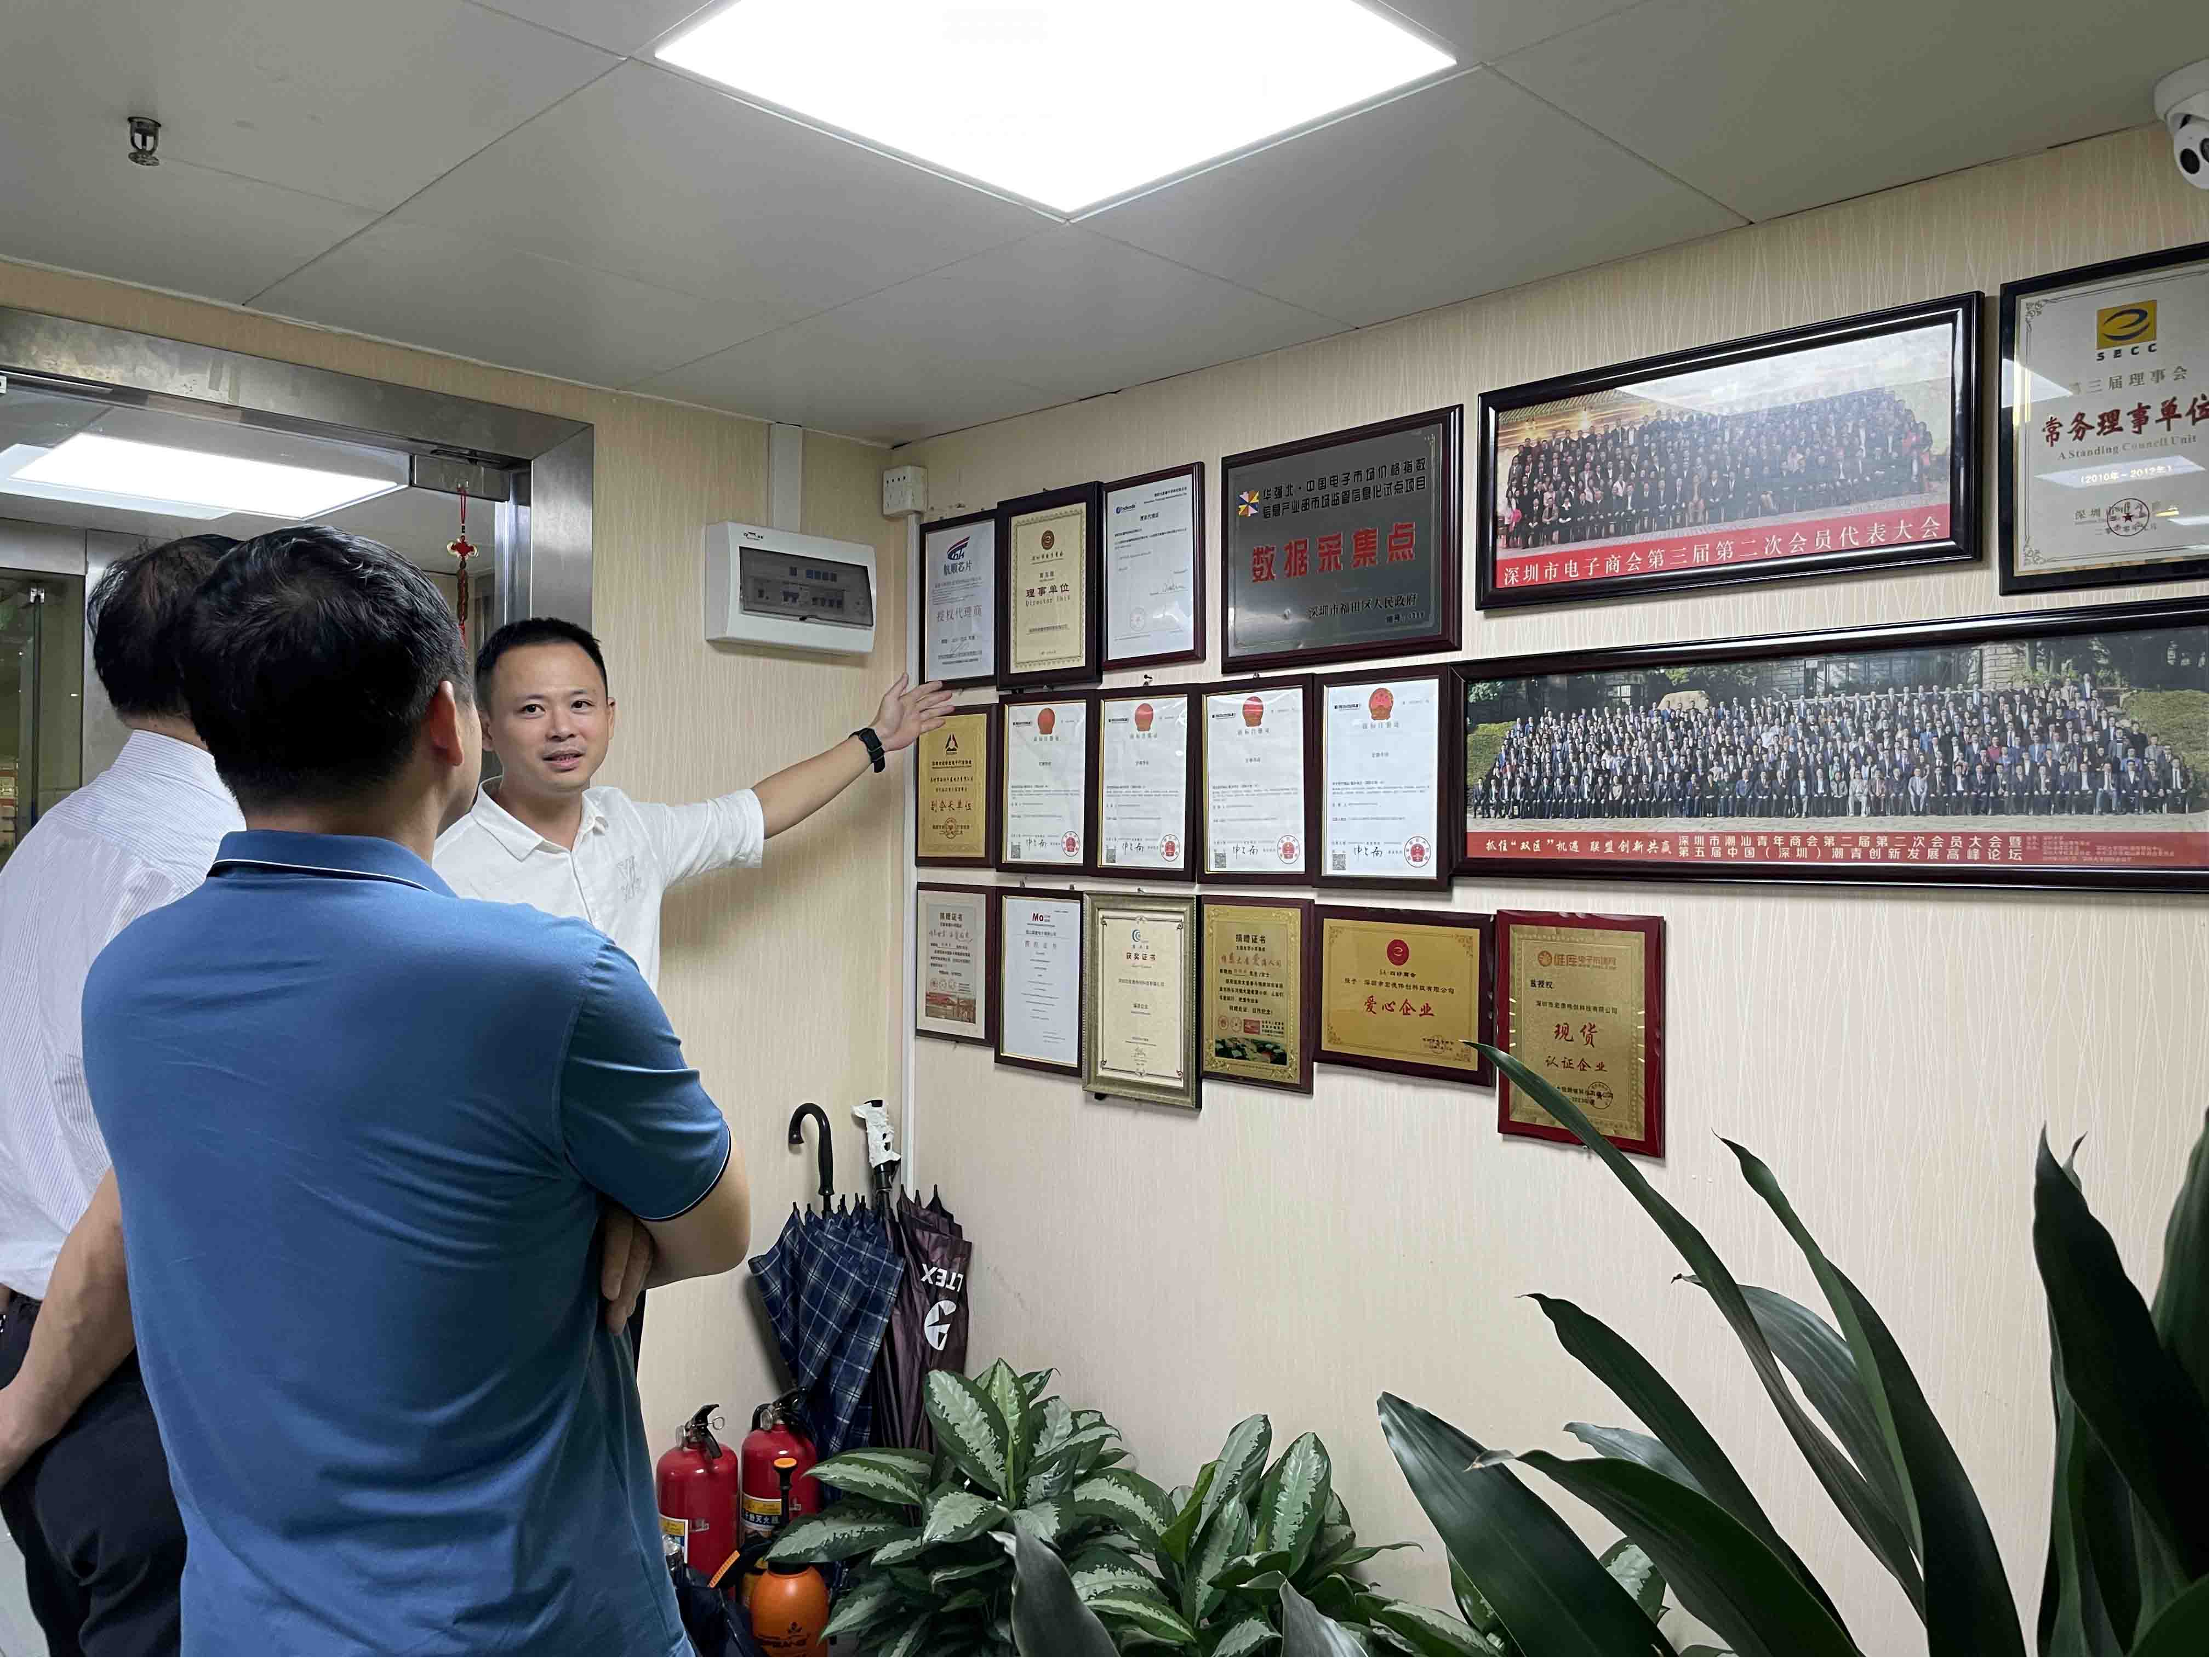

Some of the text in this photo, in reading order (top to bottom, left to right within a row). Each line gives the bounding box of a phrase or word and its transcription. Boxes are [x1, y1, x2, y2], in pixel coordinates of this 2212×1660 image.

[2096, 343, 2157, 362] SECC
[2042, 393, 2209, 447] 常务理事单位
[2058, 452, 2066, 460] A
[1251, 521, 1416, 583] 数据采集点
[1503, 514, 1941, 586] 深圳市电子商会第三届第二次会员代表大会
[1025, 583, 1070, 598] 理事单位
[1308, 592, 1417, 619] 深圳市福田区人民政府
[1678, 835, 2024, 848] 深圳市潮汕青年商会第二届第二次会员大会暨
[1678, 846, 2023, 862] 第五届中国（深圳）潮青创新发展高峰论坛
[1364, 995, 1435, 1017] 爱心企业
[1553, 1022, 1598, 1048] 现货
[1545, 1055, 1608, 1073] 认证企业
